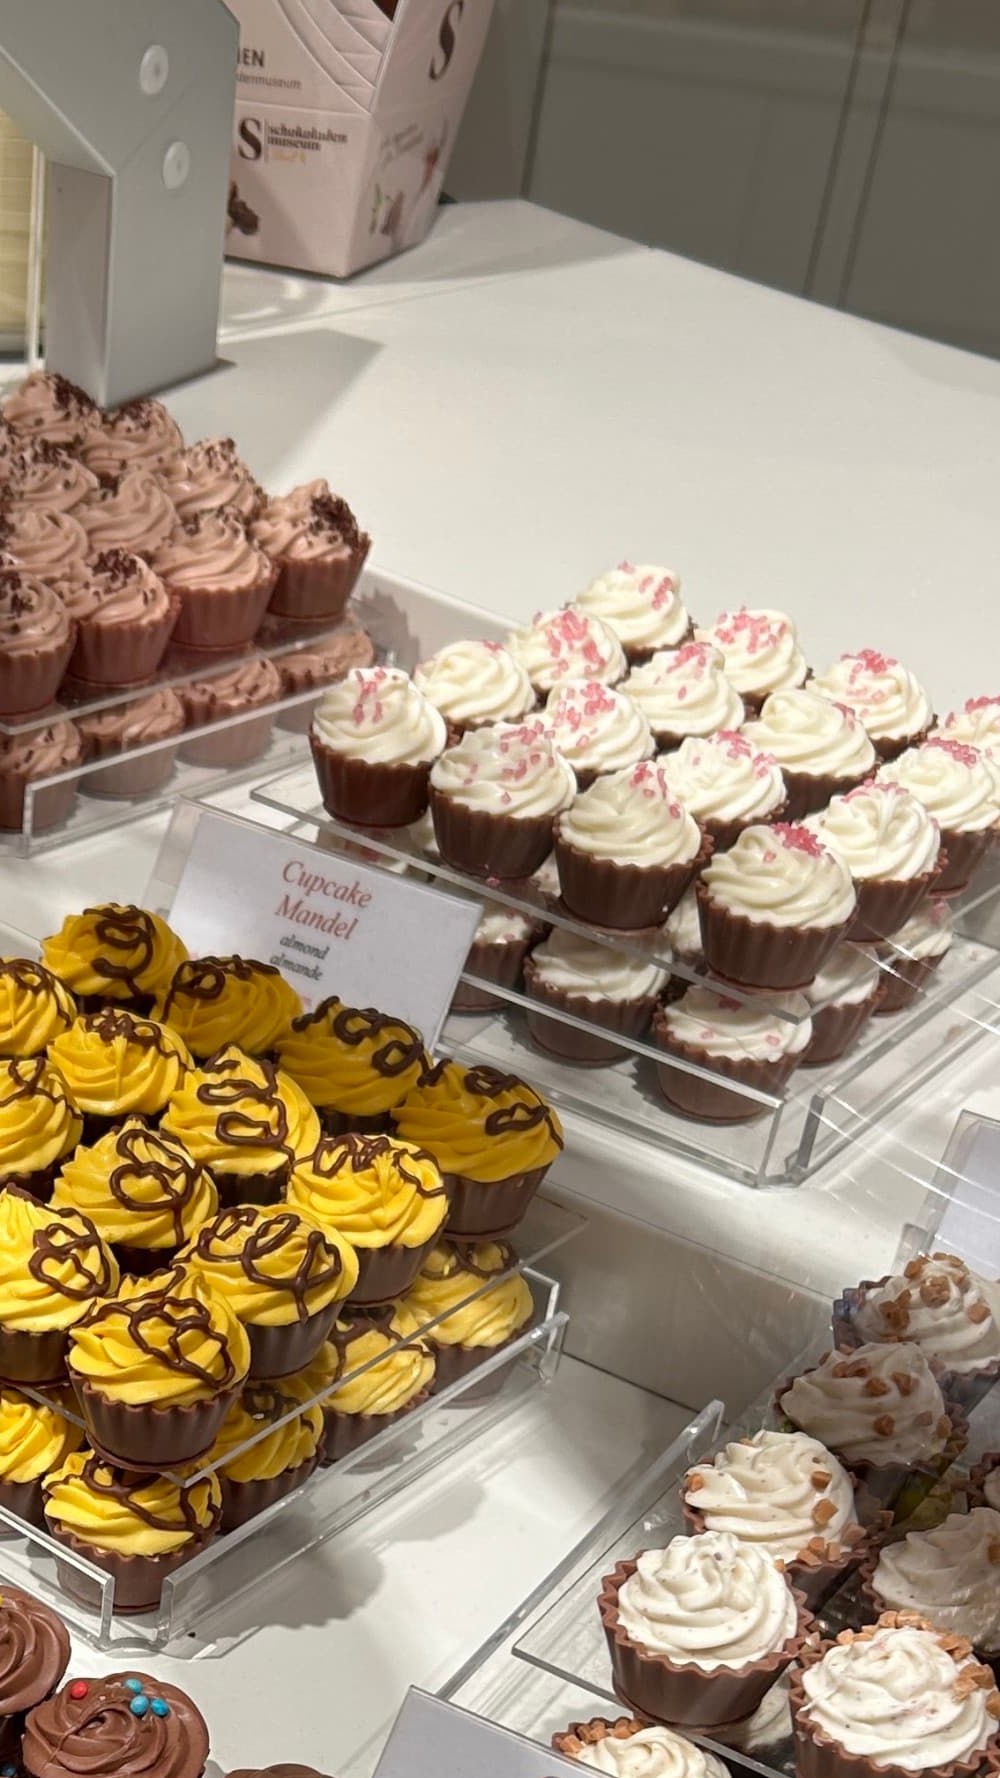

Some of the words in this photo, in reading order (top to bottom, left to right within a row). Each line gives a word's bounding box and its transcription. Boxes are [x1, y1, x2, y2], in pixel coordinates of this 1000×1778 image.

[237, 47, 266, 68] EN
[238, 117, 262, 161] S
[267, 136, 321, 151] museum
[282, 860, 373, 909] Cupcake
[274, 894, 359, 941] Mandel
[279, 934, 330, 961] almond
